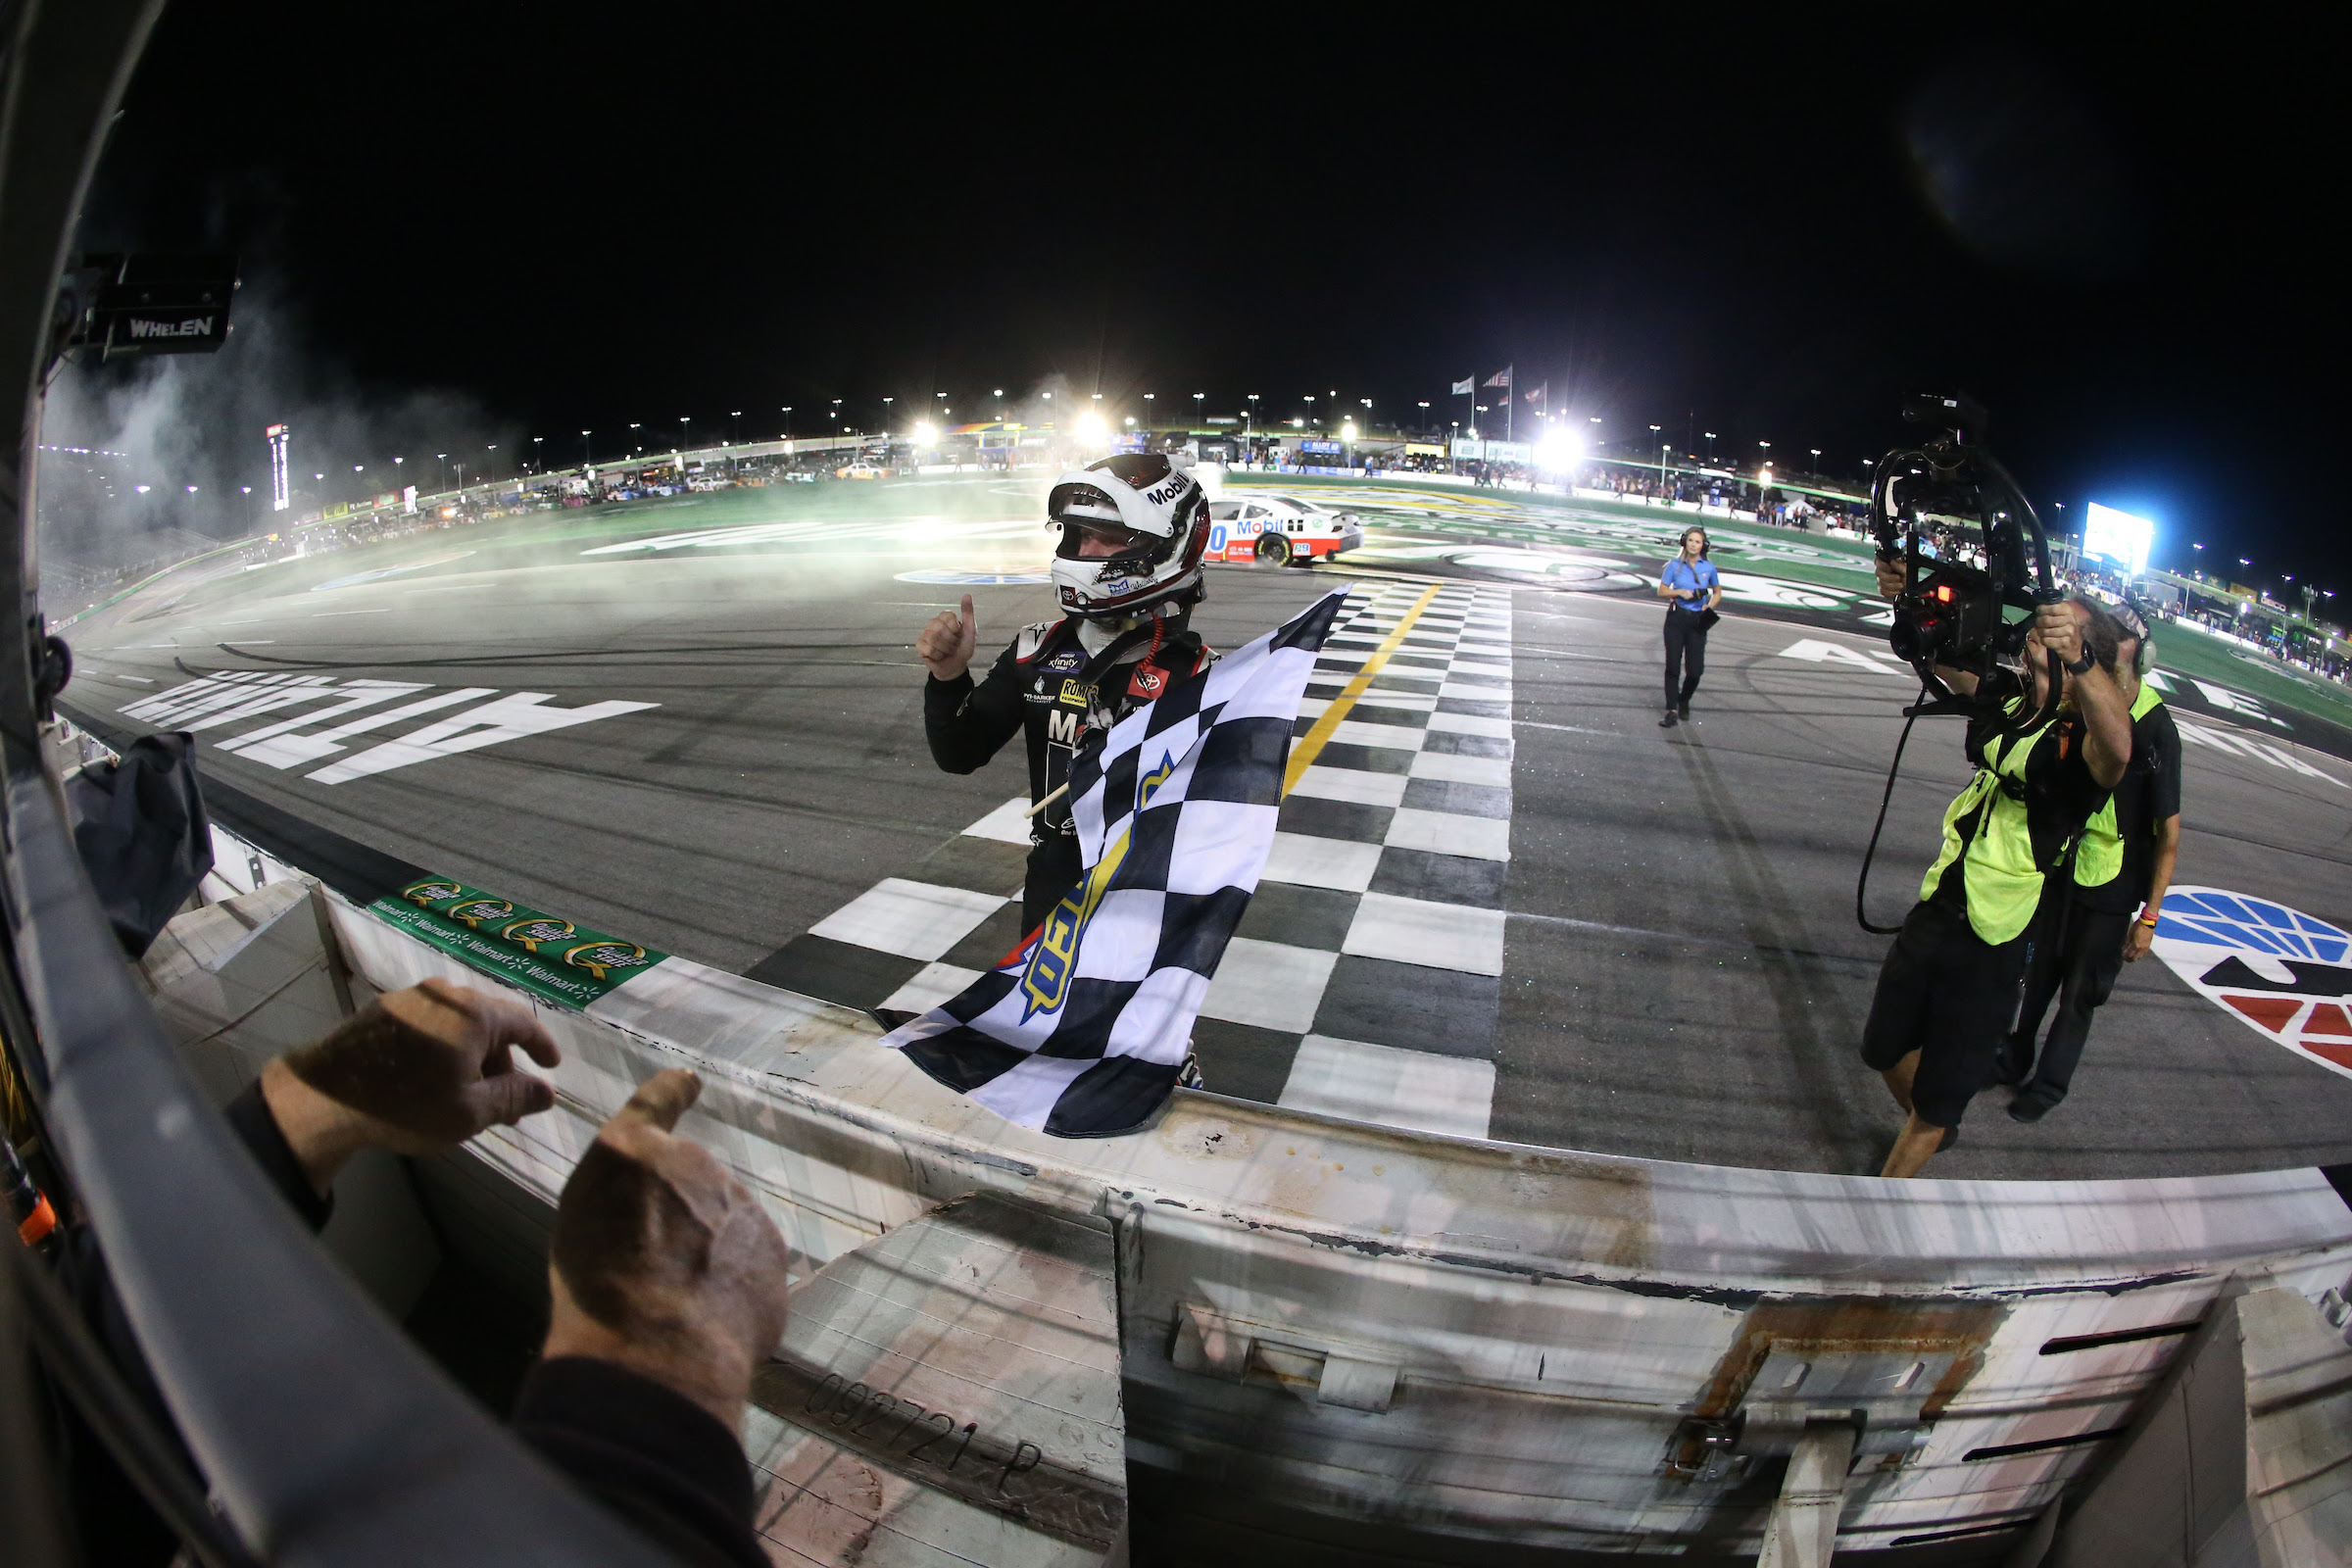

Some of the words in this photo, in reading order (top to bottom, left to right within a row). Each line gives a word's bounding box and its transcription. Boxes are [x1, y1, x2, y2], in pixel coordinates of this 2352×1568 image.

[129, 316, 214, 338] WHELEN
[1147, 475, 1188, 506] Mobil
[1238, 518, 1284, 535] Mobil
[1048, 658, 1079, 668] xfinity
[371, 899, 407, 919] Walmart
[415, 918, 457, 941] Walmart
[526, 929, 563, 942] STATE
[531, 922, 578, 941] QUAKER
[466, 940, 513, 963] Walmart
[590, 953, 633, 968] STATE
[596, 946, 650, 966] QUAKER
[525, 964, 580, 994] Walmart
